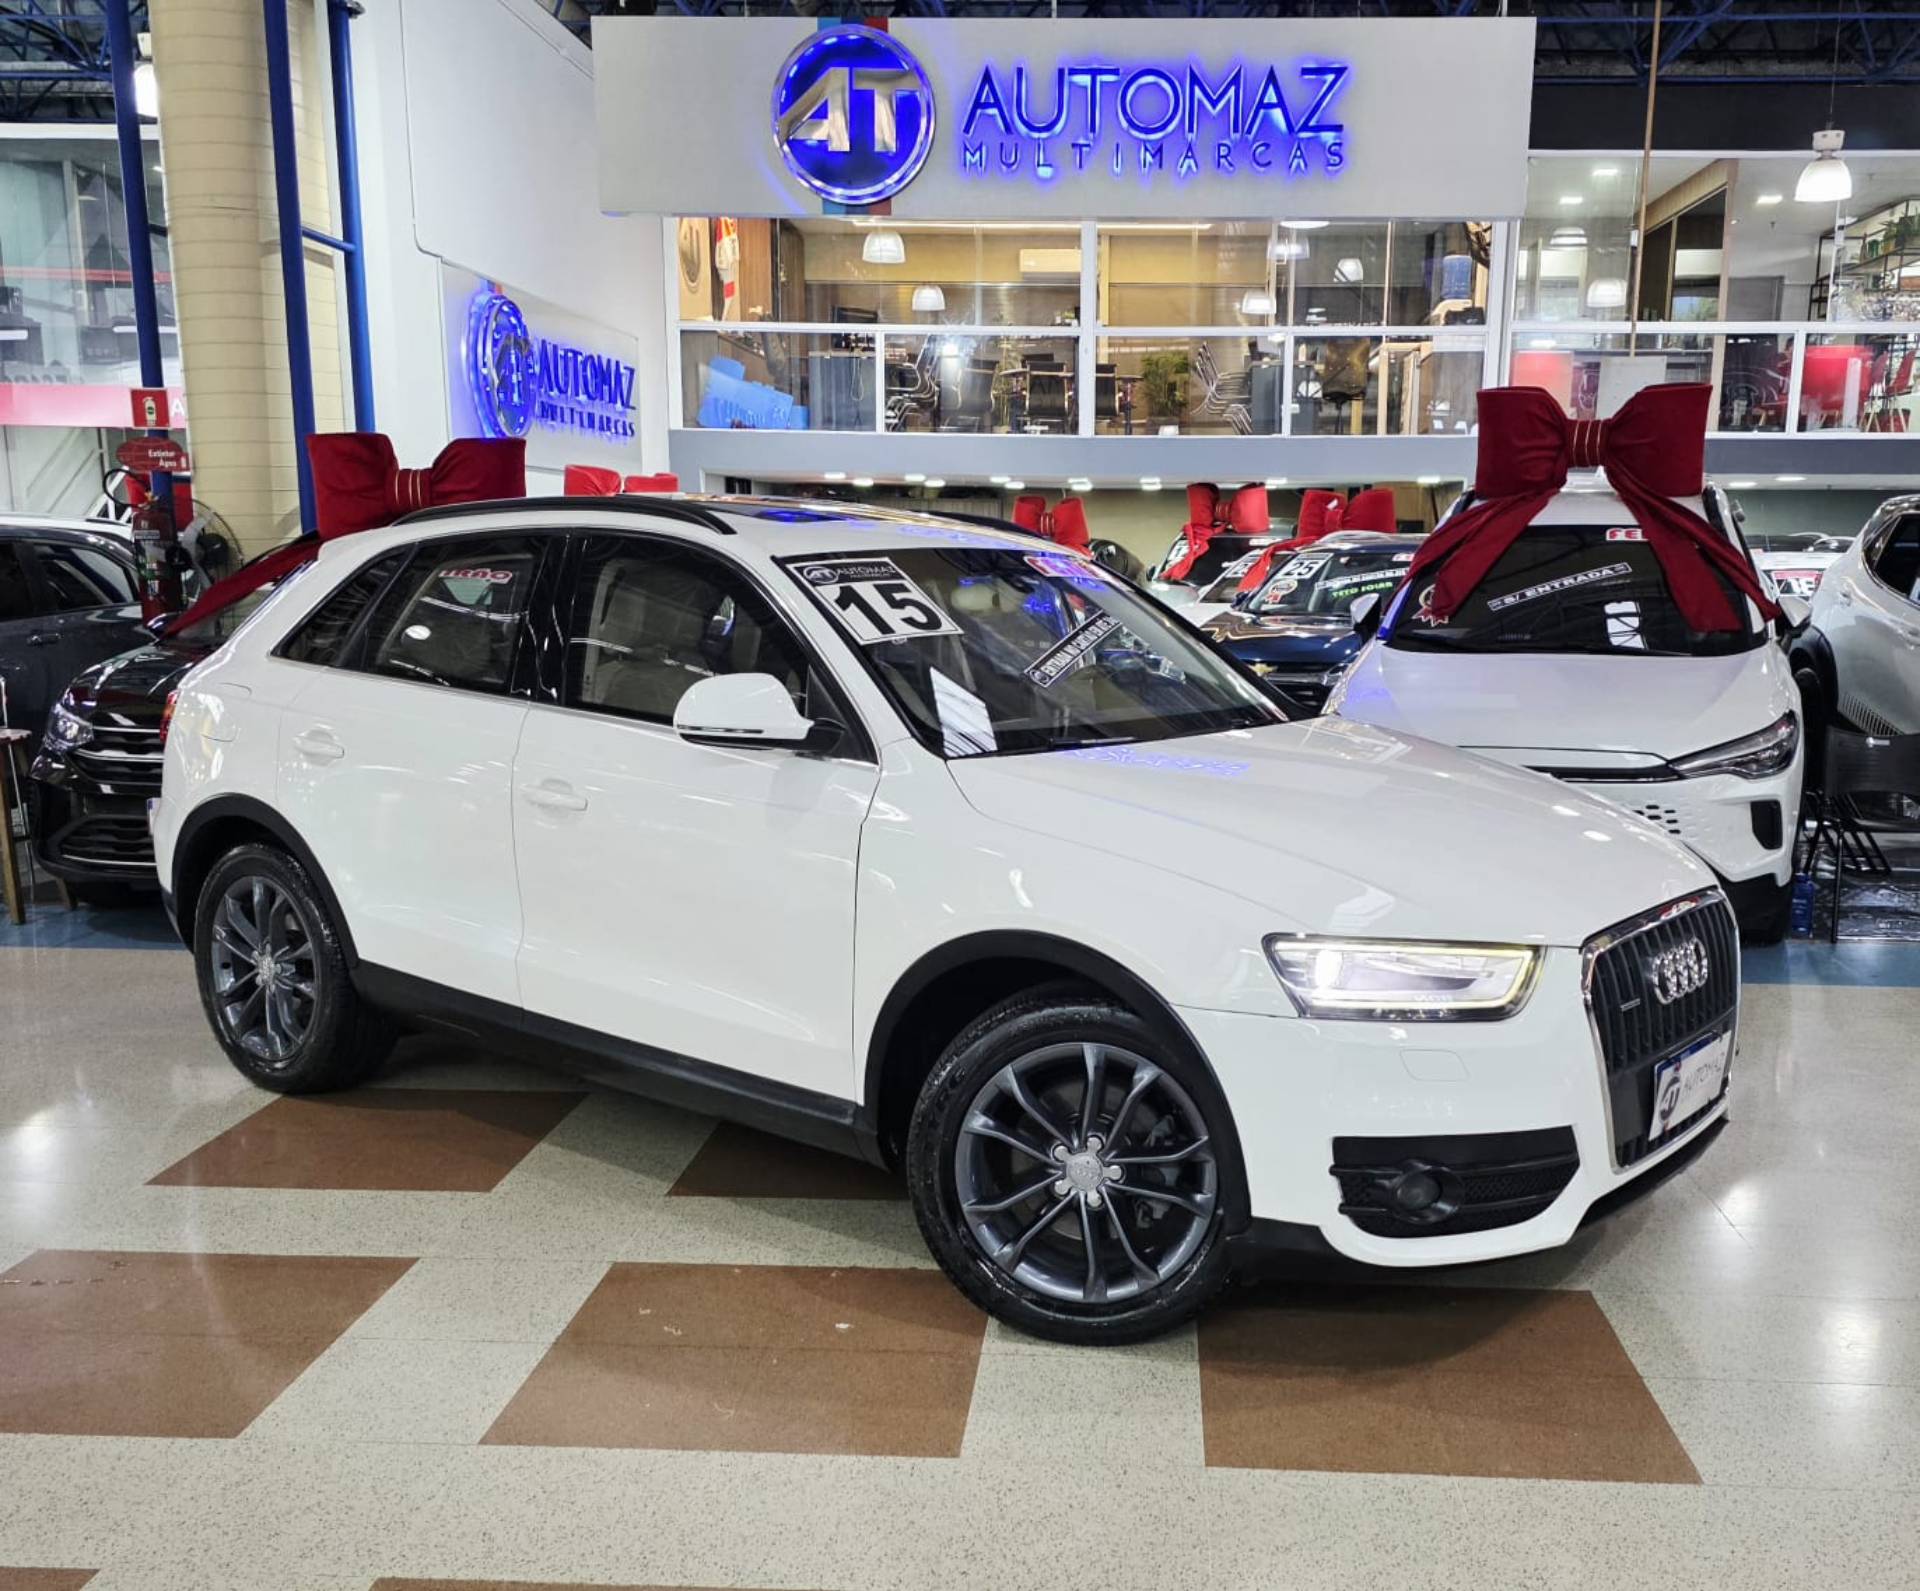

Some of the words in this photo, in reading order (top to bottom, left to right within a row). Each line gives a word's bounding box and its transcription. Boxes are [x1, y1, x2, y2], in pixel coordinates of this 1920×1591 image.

[962, 64, 1348, 139] AUTOMAZ
[962, 141, 1345, 178] MULTIMARCAS
[537, 338, 636, 410] AUTOMAZ
[540, 401, 635, 436] MULTIMARCAS
[1283, 561, 1320, 576] 25
[1525, 568, 1614, 597] ENTRADA
[834, 583, 942, 635] 15
